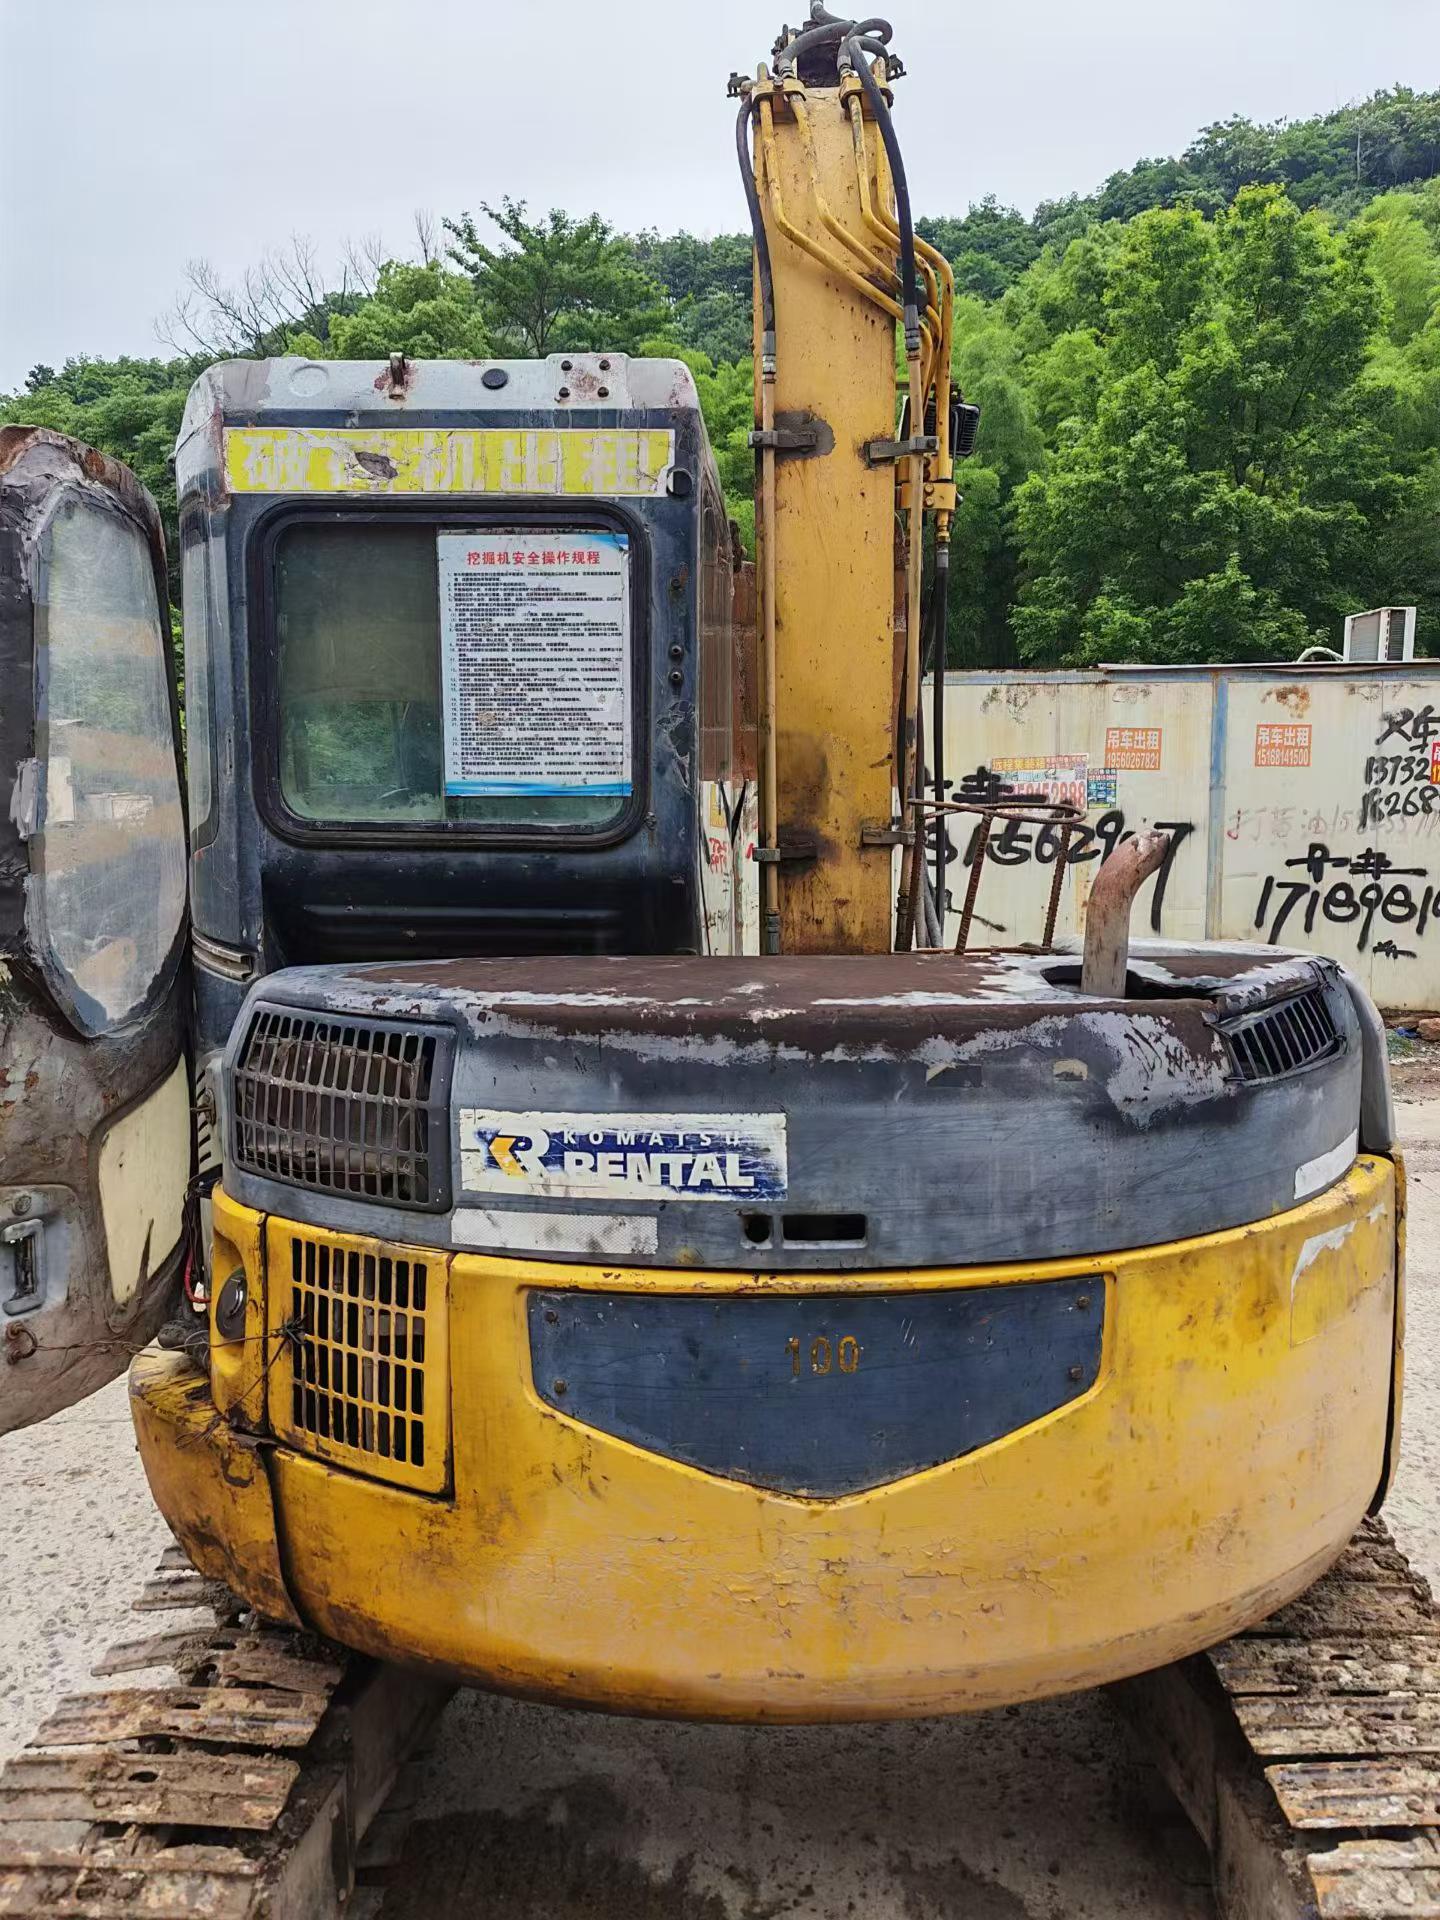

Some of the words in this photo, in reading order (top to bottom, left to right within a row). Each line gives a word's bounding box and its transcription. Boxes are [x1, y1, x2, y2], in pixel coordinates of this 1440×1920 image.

[467, 551, 600, 566] 挖掘机安全操作规程
[1107, 730, 1159, 749] 吊车出租
[1256, 727, 1310, 747] 吊车出租
[1106, 752, 1159, 769] 19560267821
[1256, 749, 1309, 766] 15168141500
[563, 1130, 742, 1147] KOMATSU
[564, 1151, 754, 1187] RENTAL
[784, 1335, 860, 1376] 100
